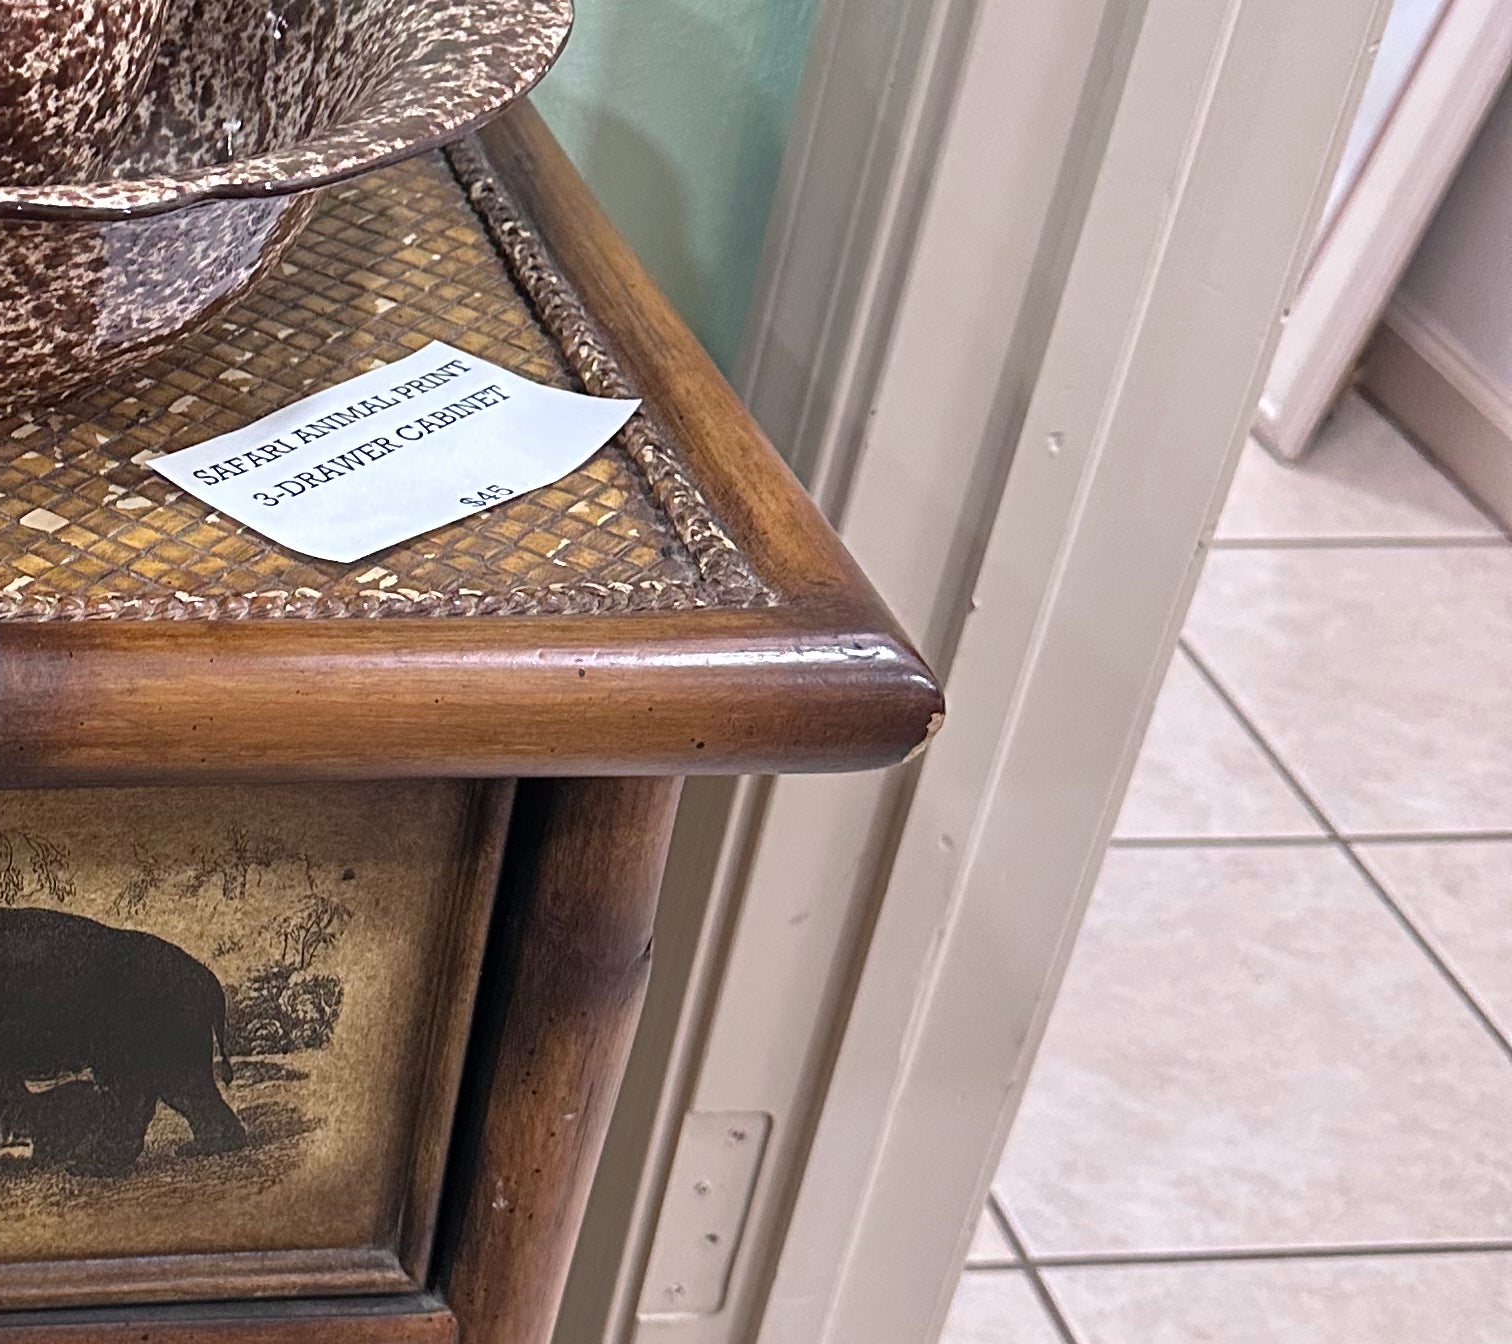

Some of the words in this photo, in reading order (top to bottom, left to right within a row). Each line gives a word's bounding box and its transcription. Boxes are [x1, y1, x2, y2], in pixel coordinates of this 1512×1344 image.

[192, 438, 299, 487] SAFARI
[291, 393, 401, 445] ANIMAL
[397, 359, 472, 400] PRINT
[252, 437, 404, 508] 3-DRAWER
[395, 384, 511, 441] CABINET
[459, 484, 515, 509] $45
